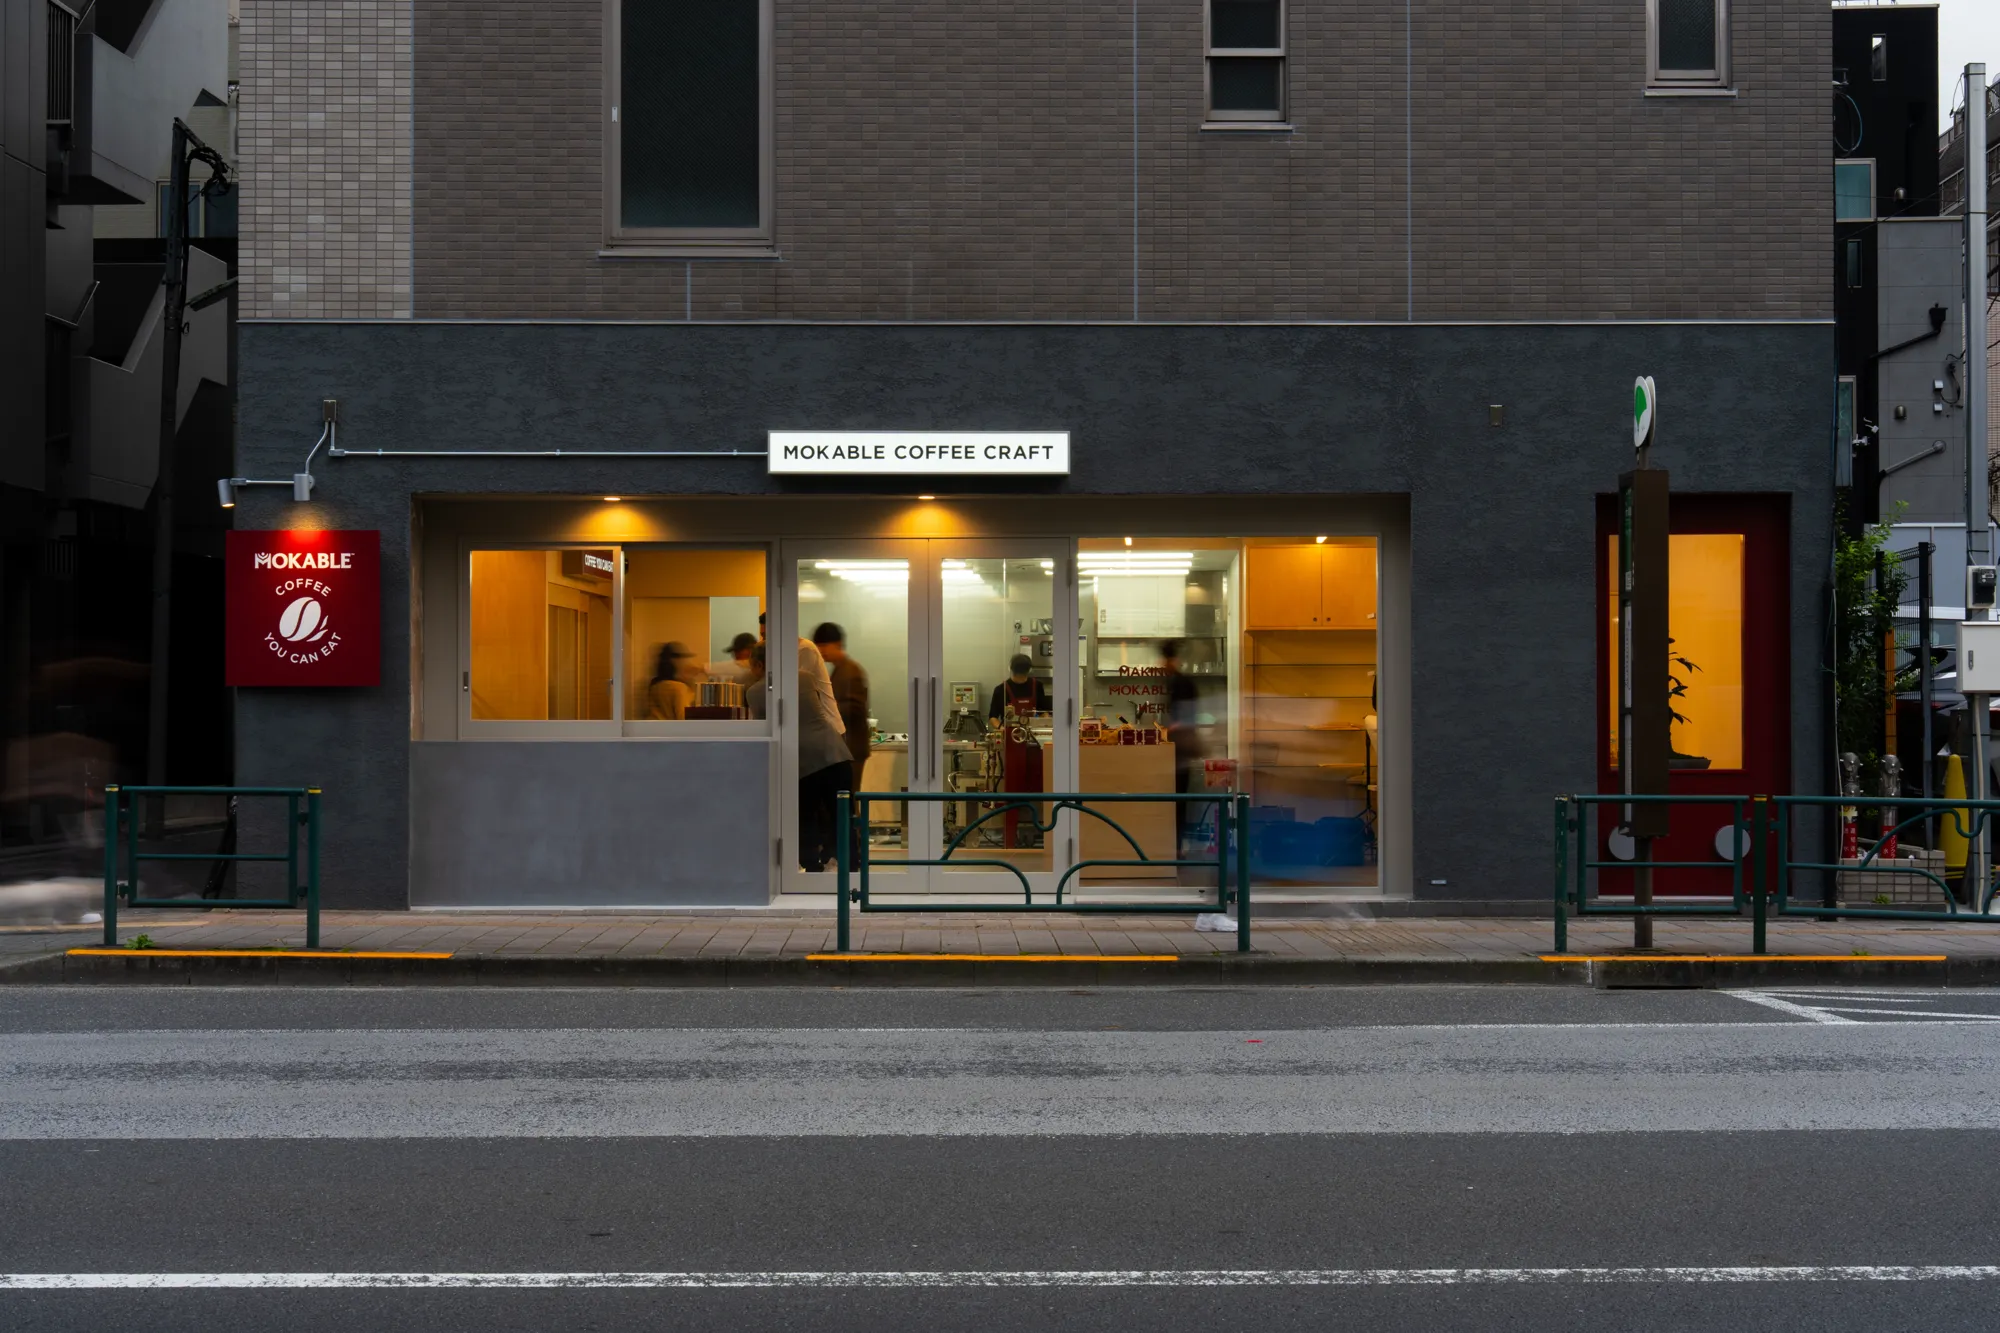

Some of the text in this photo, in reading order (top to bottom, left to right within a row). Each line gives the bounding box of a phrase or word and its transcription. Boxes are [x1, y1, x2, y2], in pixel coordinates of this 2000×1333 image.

[784, 445, 1053, 460] MOKABLE COFFEE CRAFT
[275, 578, 331, 597] COFFEE
[264, 632, 341, 664] YOU CAN EAT
[1109, 684, 1172, 696] MOKABL
